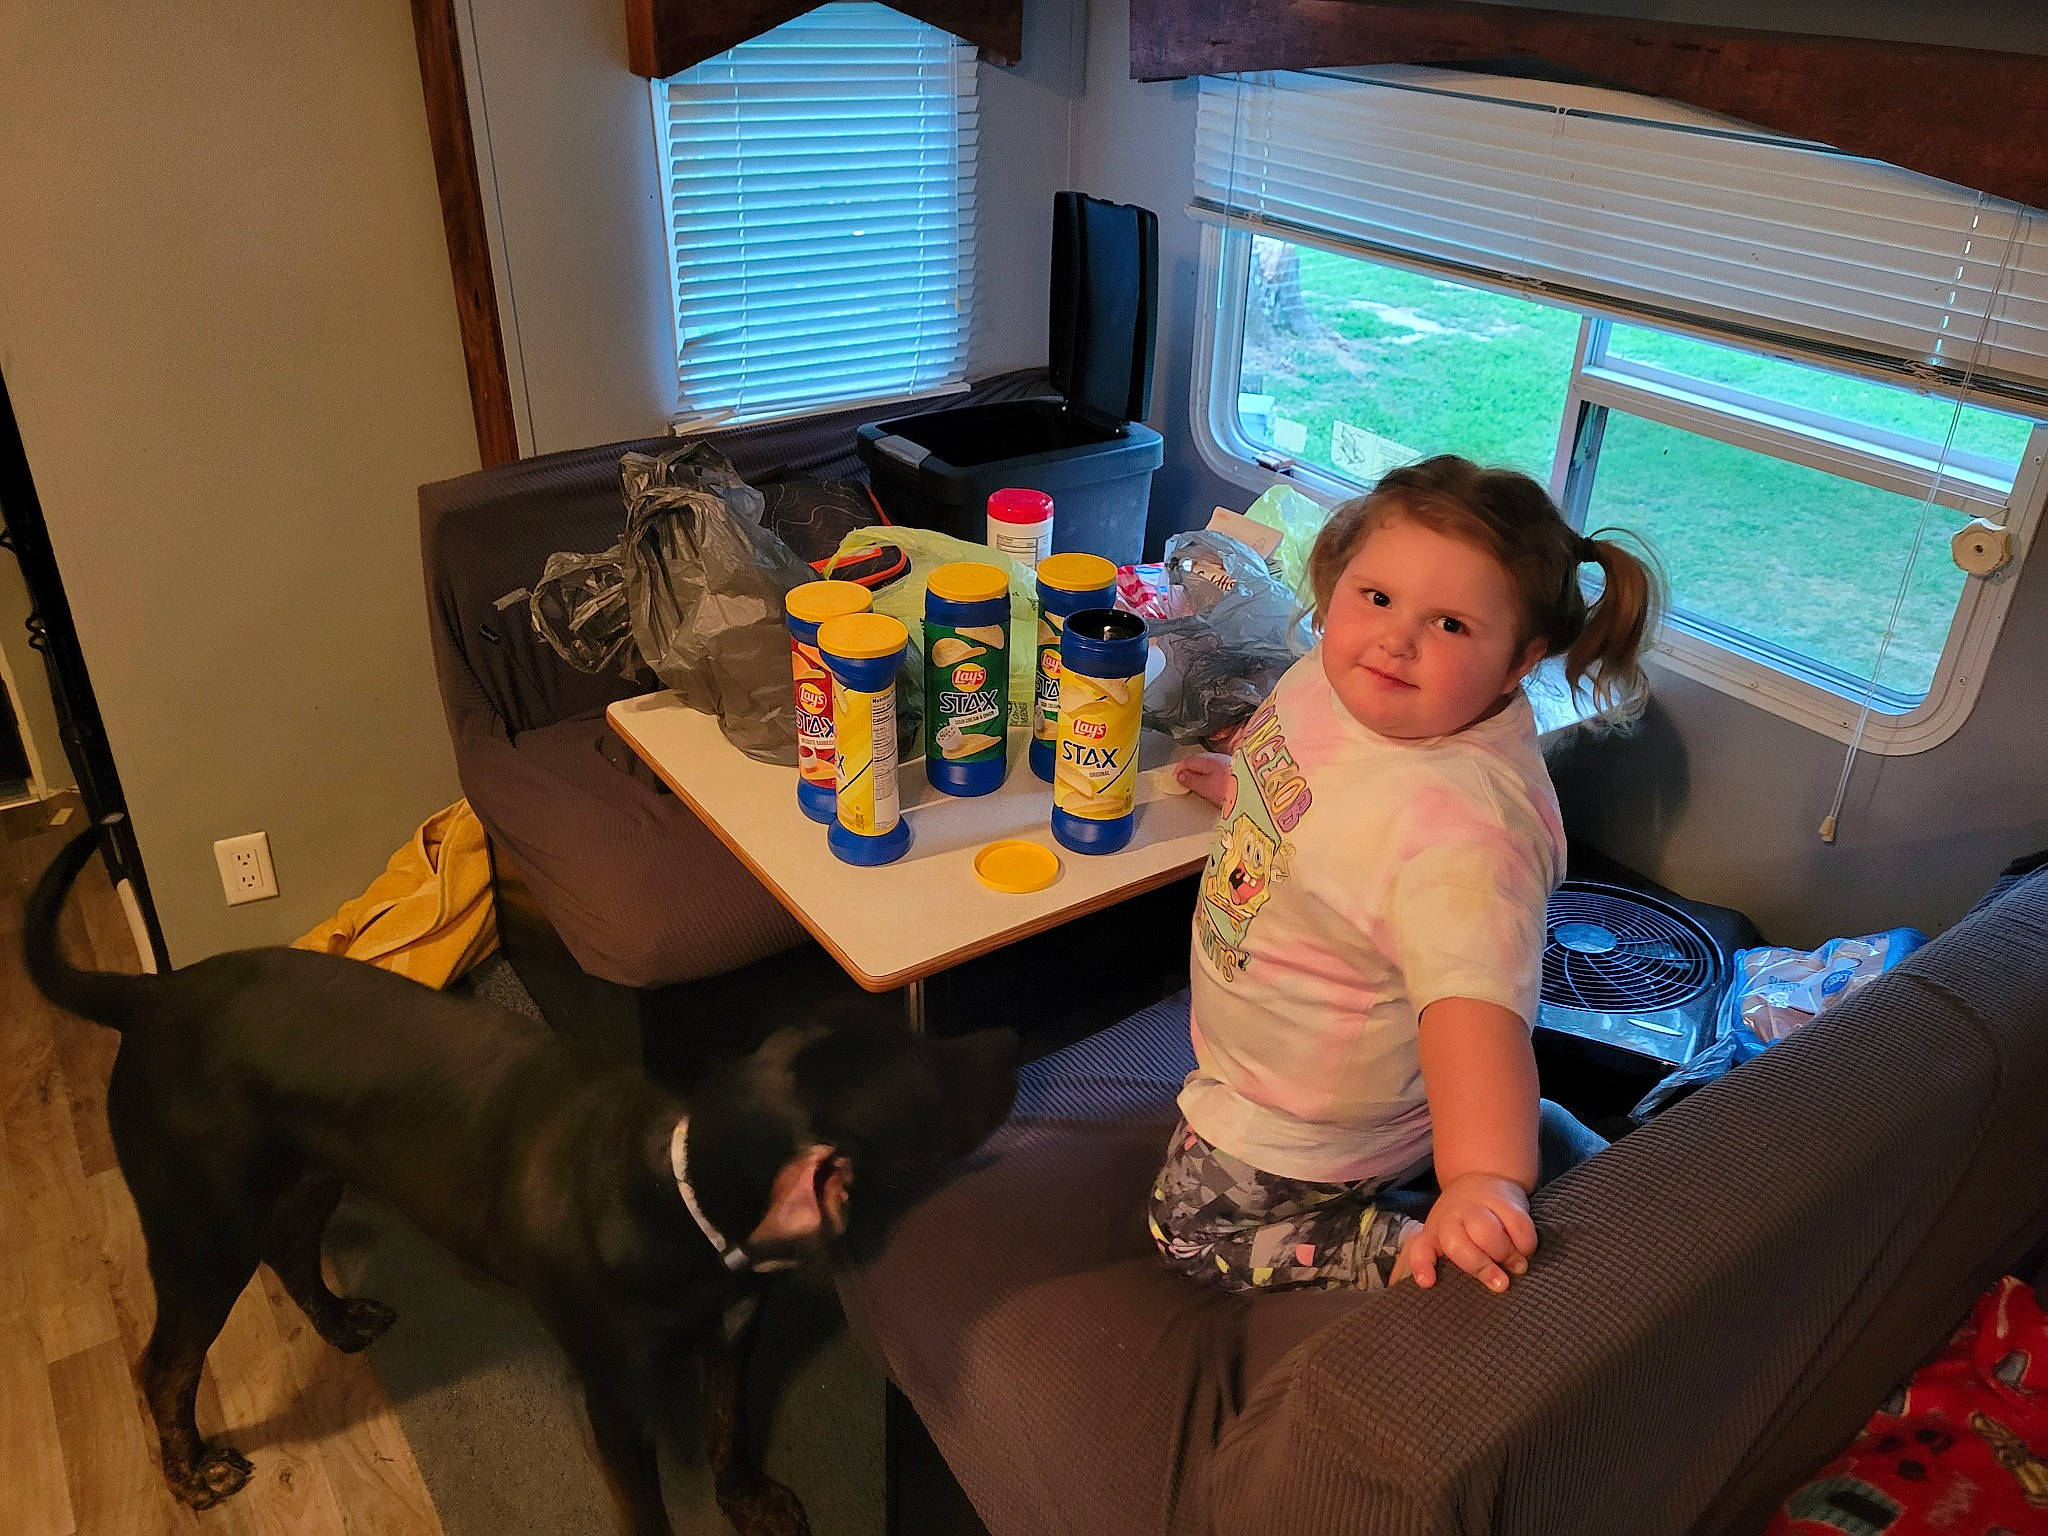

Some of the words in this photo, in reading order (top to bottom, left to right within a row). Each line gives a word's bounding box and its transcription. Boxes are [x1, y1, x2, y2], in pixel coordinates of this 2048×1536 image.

[1035, 671, 1060, 700] STA
[939, 689, 999, 715] STAX
[1062, 740, 1119, 769] STAX
[1089, 770, 1111, 778] ORIGINAL
